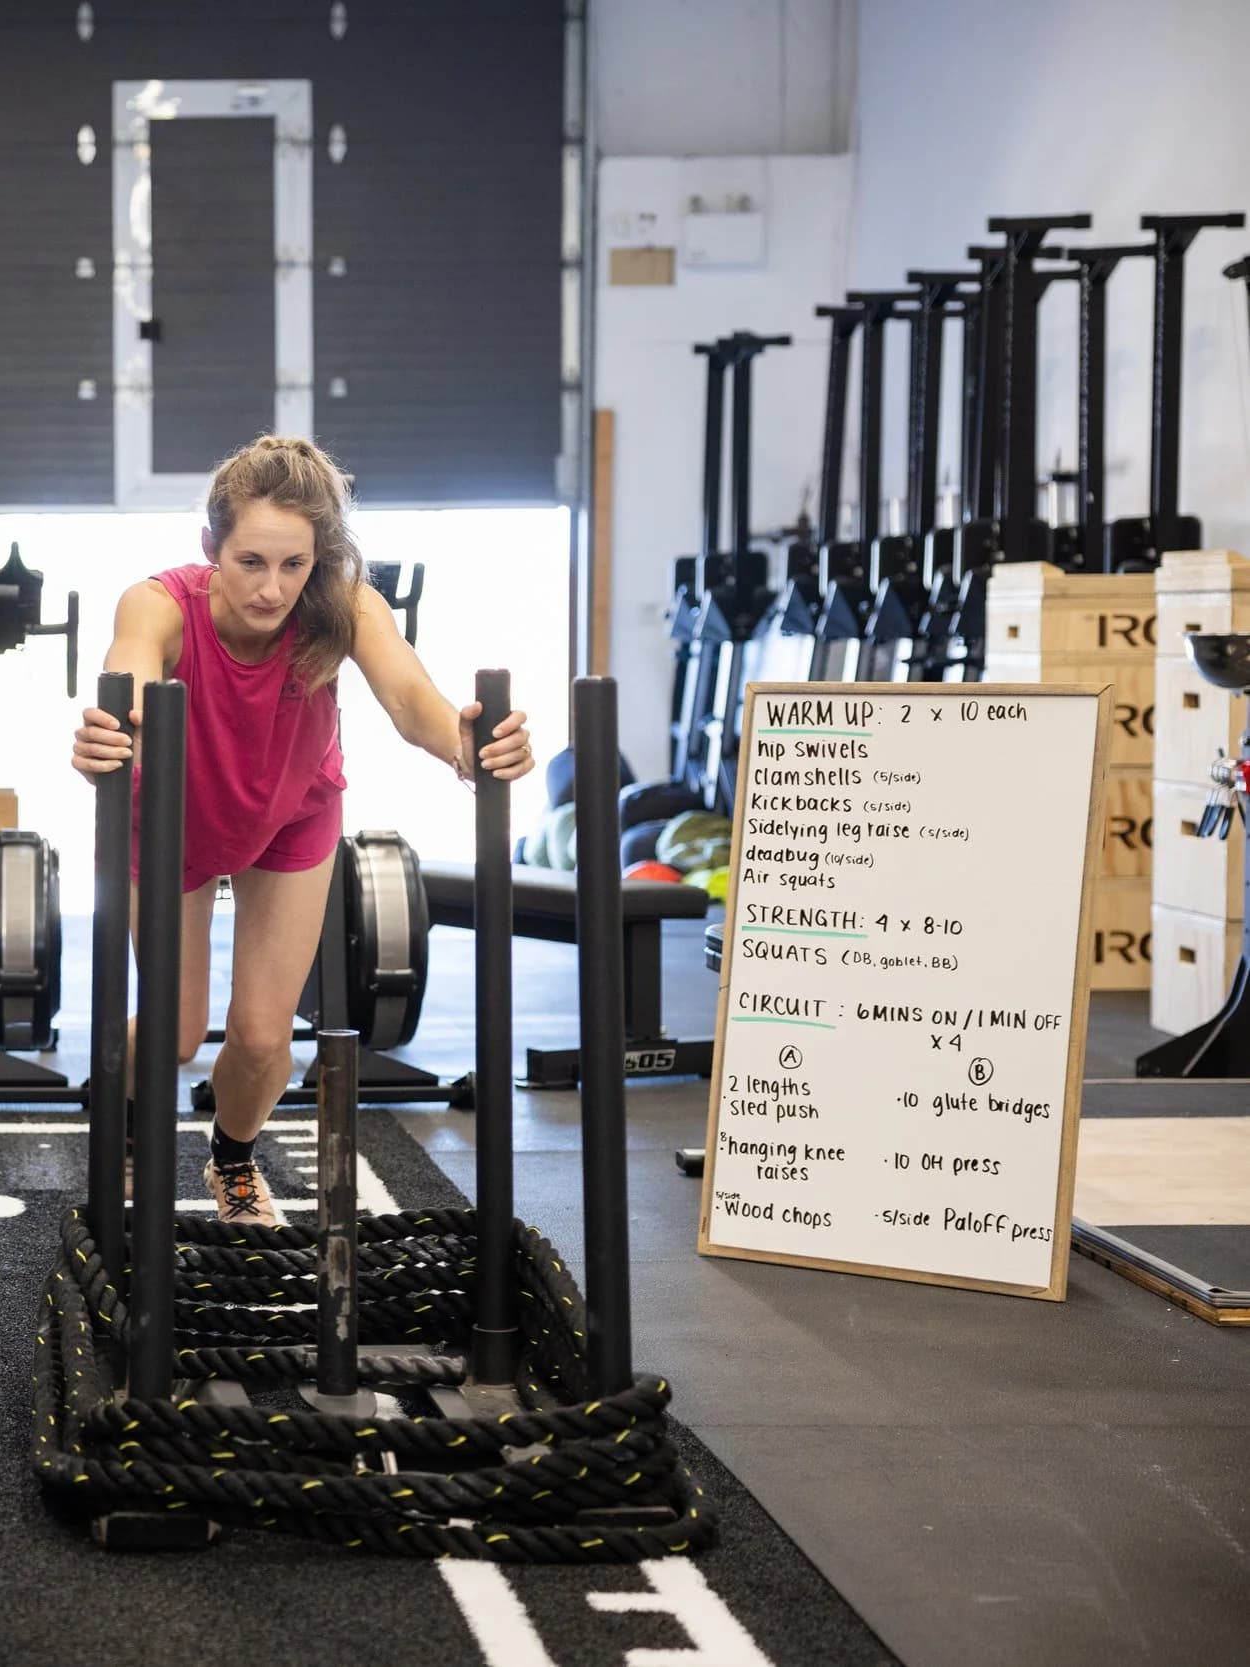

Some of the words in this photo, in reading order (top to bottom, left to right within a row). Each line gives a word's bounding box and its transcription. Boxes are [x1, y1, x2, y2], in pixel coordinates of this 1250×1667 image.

[766, 700, 834, 727] WARM
[844, 700, 883, 728] UP:
[900, 703, 912, 723] 2
[961, 700, 979, 722] 10
[987, 702, 1027, 722] each
[758, 740, 786, 761] hip
[794, 740, 869, 759] swivels
[873, 770, 922, 785] (5/side)
[748, 818, 828, 844] Sidelying
[837, 822, 861, 843] leg
[867, 822, 910, 838] raise
[746, 845, 819, 871] deadbug
[824, 851, 875, 869] (10/side)
[743, 868, 770, 884] Air
[779, 872, 836, 891] squats
[746, 903, 866, 930] STRENGTH:
[875, 914, 889, 932] 4
[923, 916, 963, 935] 8-10
[742, 938, 828, 966] SQUATS
[931, 956, 959, 971] BB)
[931, 1009, 957, 1026] ON
[1033, 1014, 1062, 1031] OFF
[728, 1075, 739, 1092] 2
[747, 1075, 811, 1102] lengths
[776, 1104, 819, 1124] push
[932, 1092, 979, 1117] glute
[988, 1093, 1051, 1124] bridges
[728, 1136, 798, 1166] hanging
[804, 1143, 846, 1162] knee
[894, 1152, 910, 1170] 10
[921, 1153, 943, 1171] OH
[953, 1157, 1002, 1176] press
[757, 1164, 809, 1181] raises
[782, 1206, 833, 1230] chops
[944, 1207, 1011, 1234] Paloff
[1011, 1223, 1053, 1242] press
